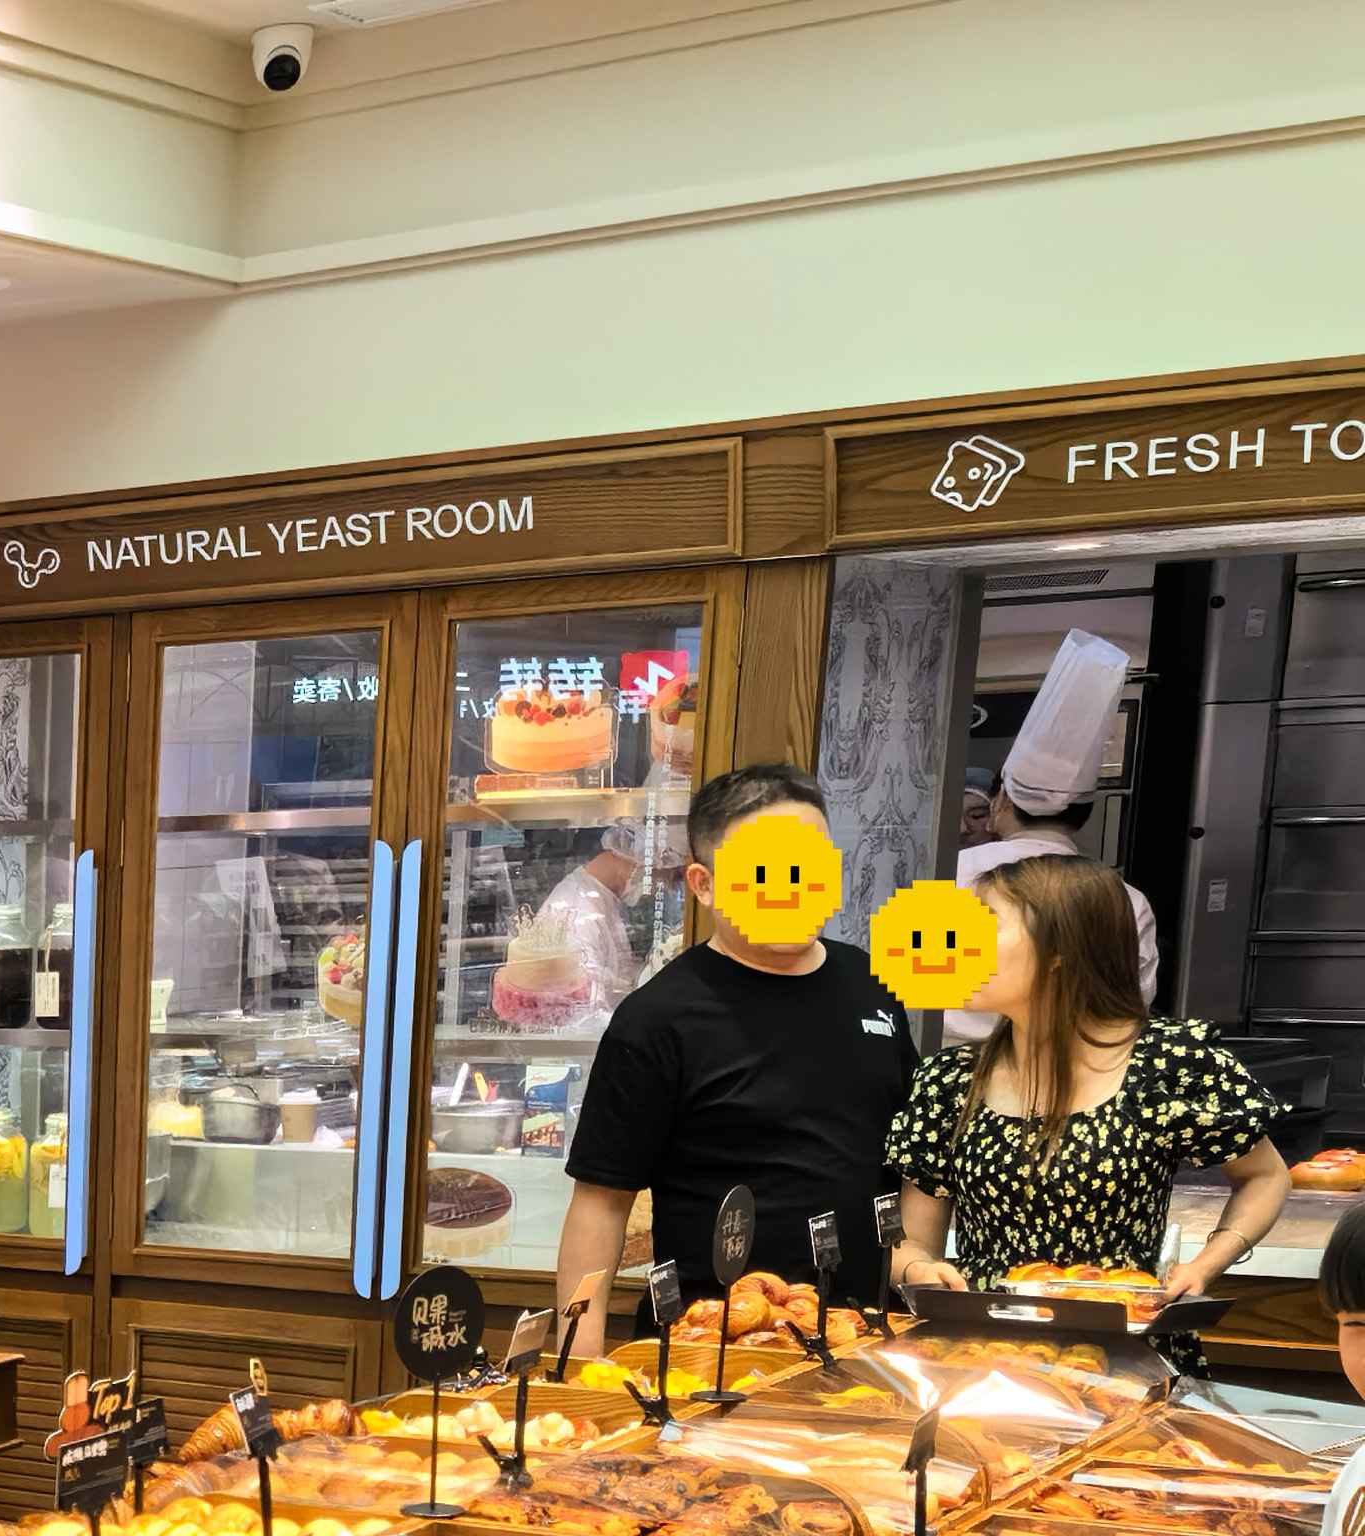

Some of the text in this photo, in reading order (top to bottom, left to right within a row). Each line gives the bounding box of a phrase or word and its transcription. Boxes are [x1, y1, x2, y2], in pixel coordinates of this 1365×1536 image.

[1066, 420, 1365, 483] FRESH TO
[86, 495, 535, 573] NATURAL YEAST ROOM
